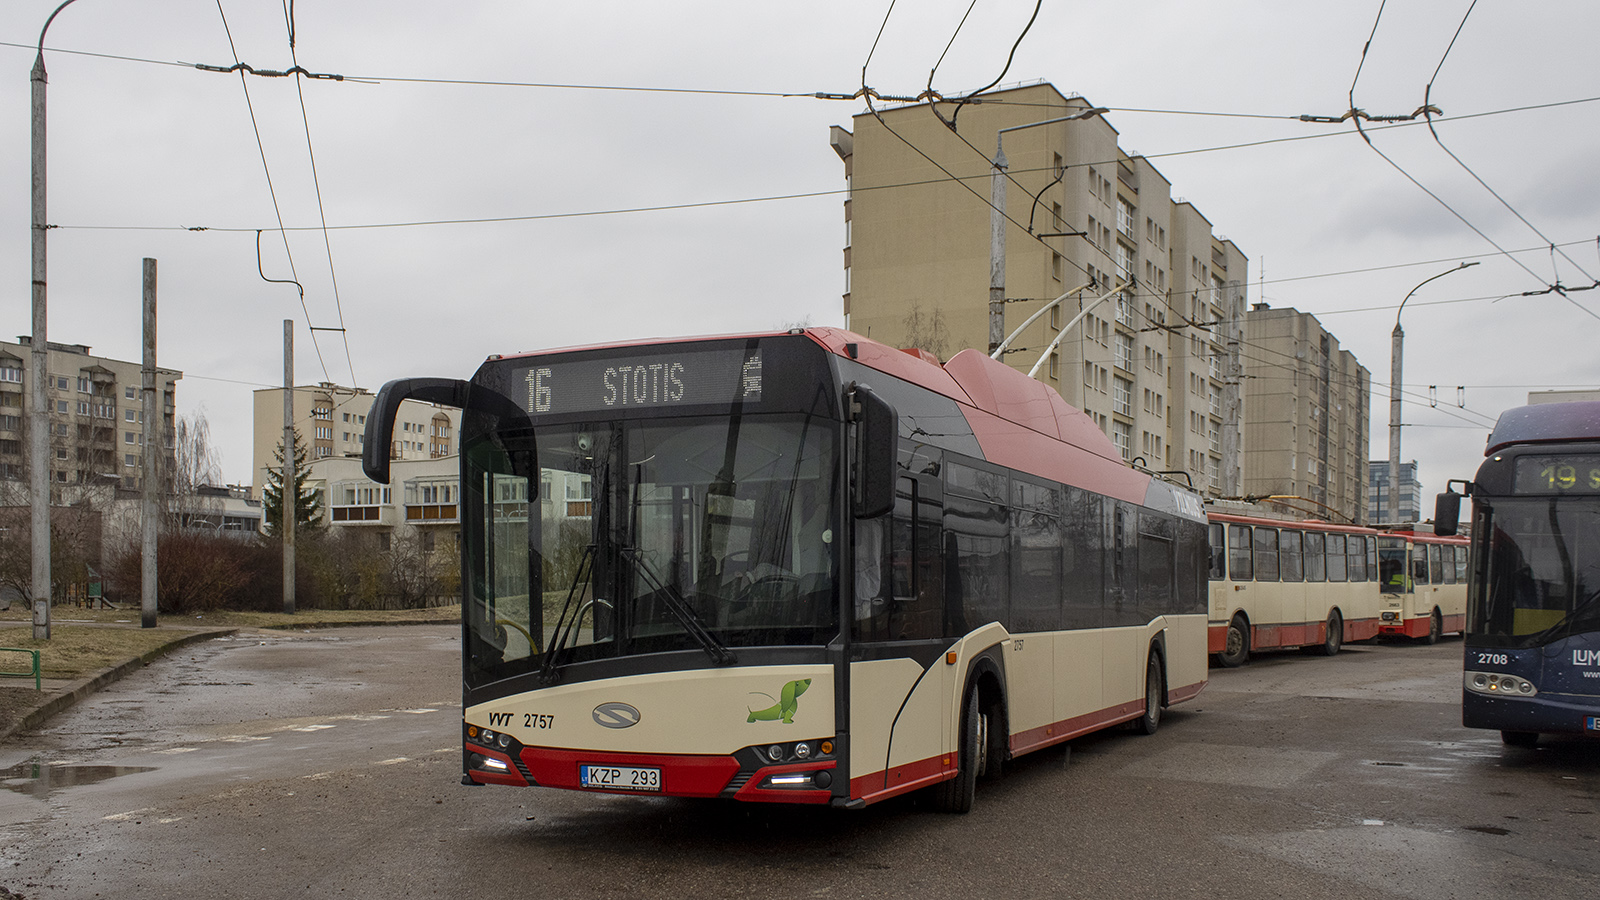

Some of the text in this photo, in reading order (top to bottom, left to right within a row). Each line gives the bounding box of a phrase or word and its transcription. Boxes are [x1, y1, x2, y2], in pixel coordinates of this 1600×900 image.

[524, 361, 684, 413] 16 STOTIS
[1541, 464, 1600, 489] 19 S
[1014, 639, 1024, 651] 2757
[1477, 653, 1509, 665] 2708
[1572, 649, 1600, 666] LUM
[489, 712, 555, 730] VVT 2757
[589, 767, 621, 784] KZP
[630, 769, 658, 786] 293
